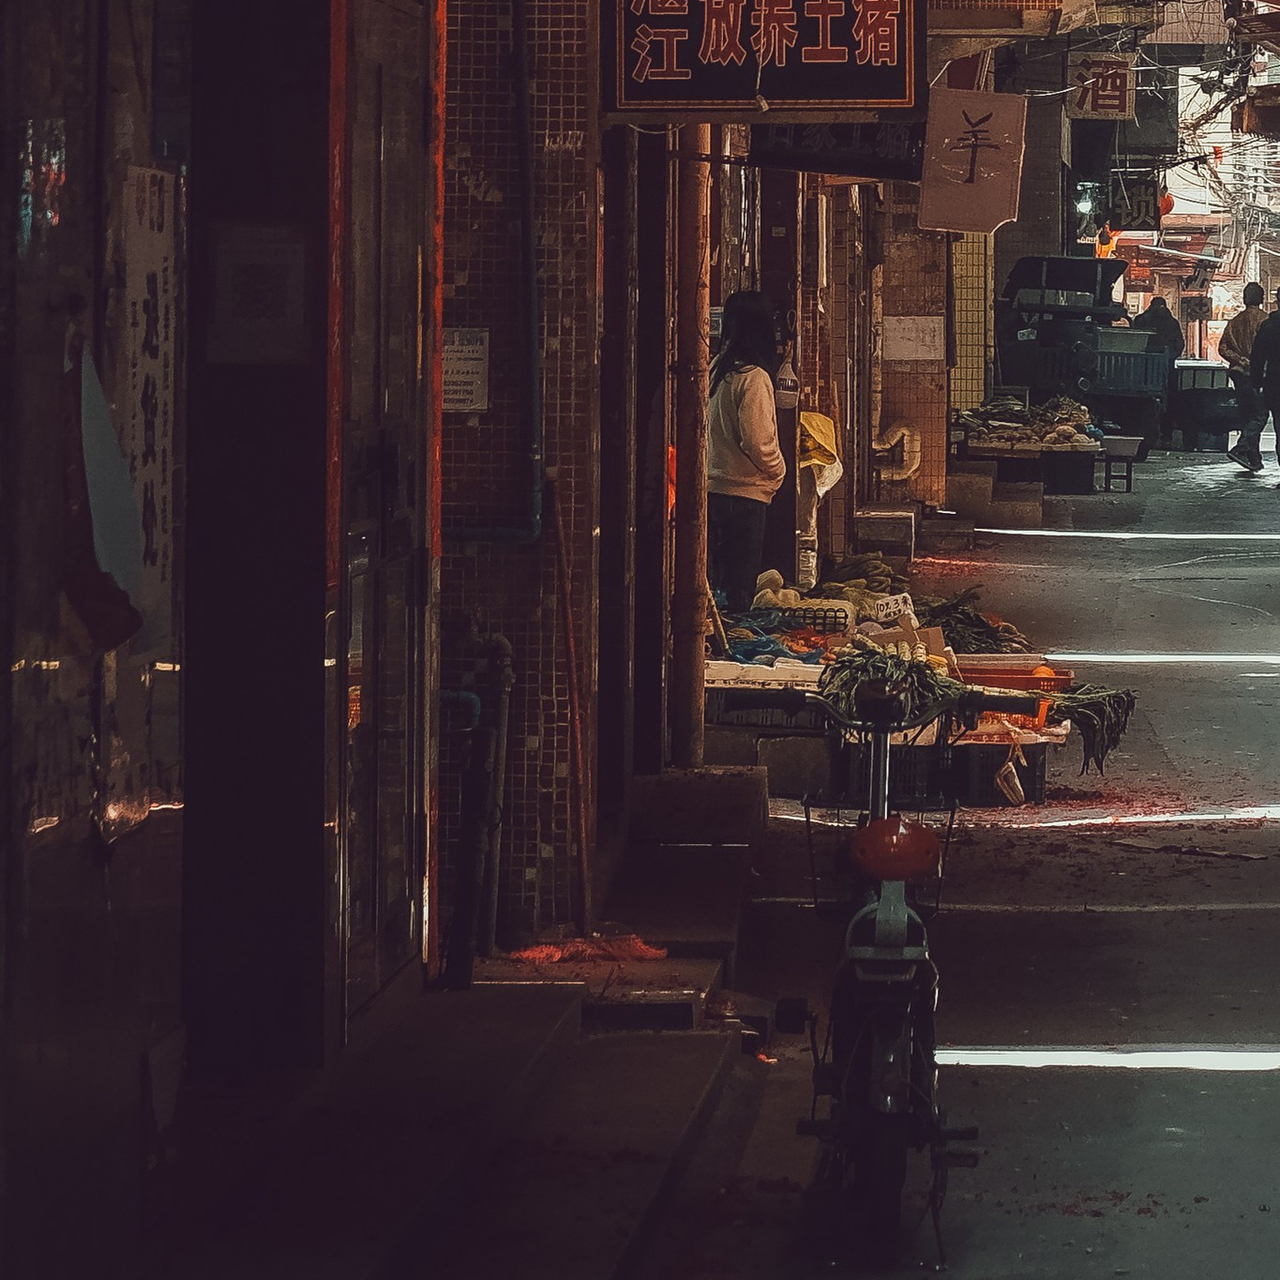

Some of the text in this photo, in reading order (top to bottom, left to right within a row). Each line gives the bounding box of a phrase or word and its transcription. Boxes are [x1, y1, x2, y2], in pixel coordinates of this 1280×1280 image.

[1075, 57, 1130, 114] 酒
[950, 109, 1000, 184] 羊
[1115, 185, 1157, 227] 锁
